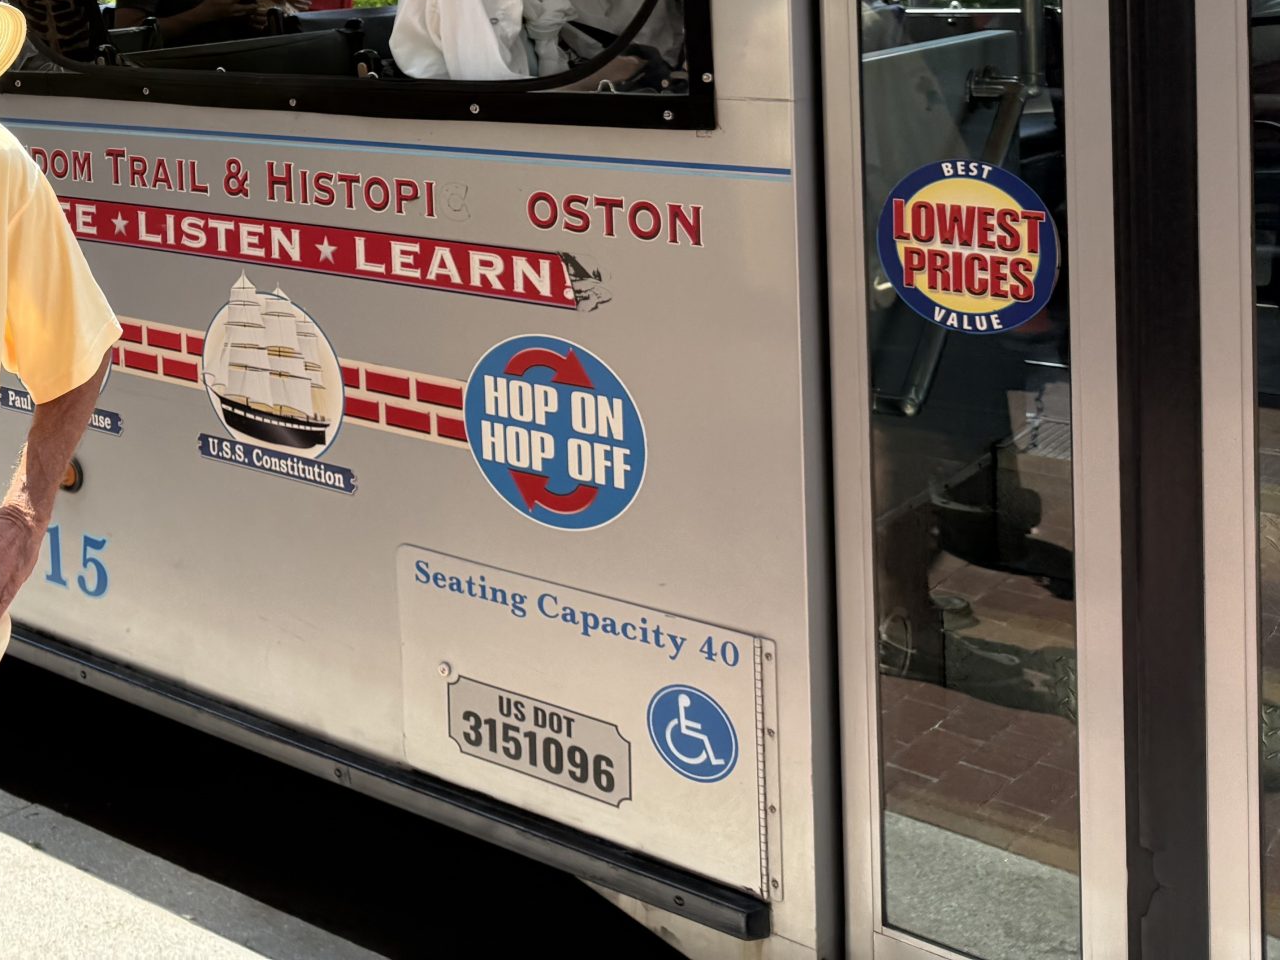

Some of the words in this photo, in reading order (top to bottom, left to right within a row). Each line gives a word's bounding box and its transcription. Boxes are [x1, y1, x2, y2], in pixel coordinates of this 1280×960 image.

[104, 147, 210, 196] TRAIL
[222, 157, 251, 199] &
[940, 161, 993, 180] BEST
[892, 198, 1046, 254] LOWEST
[136, 209, 302, 262] LISTEN
[353, 235, 576, 301] LEARN!
[902, 246, 1036, 302] PRICES
[933, 306, 1004, 331] VALUE
[8, 390, 32, 411] Paul
[483, 374, 558, 426] HOP
[570, 391, 624, 441] ON
[208, 437, 249, 463] U.S.S.
[252, 449, 345, 489] Constitution
[480, 420, 555, 472] HOP
[567, 438, 631, 490] OFF
[46, 523, 109, 599] 15
[414, 559, 528, 617] Seating
[537, 593, 687, 660] Capacity
[699, 635, 740, 668] 40
[498, 695, 526, 722] US
[533, 706, 575, 738] DOT
[462, 710, 615, 793] 3151096
